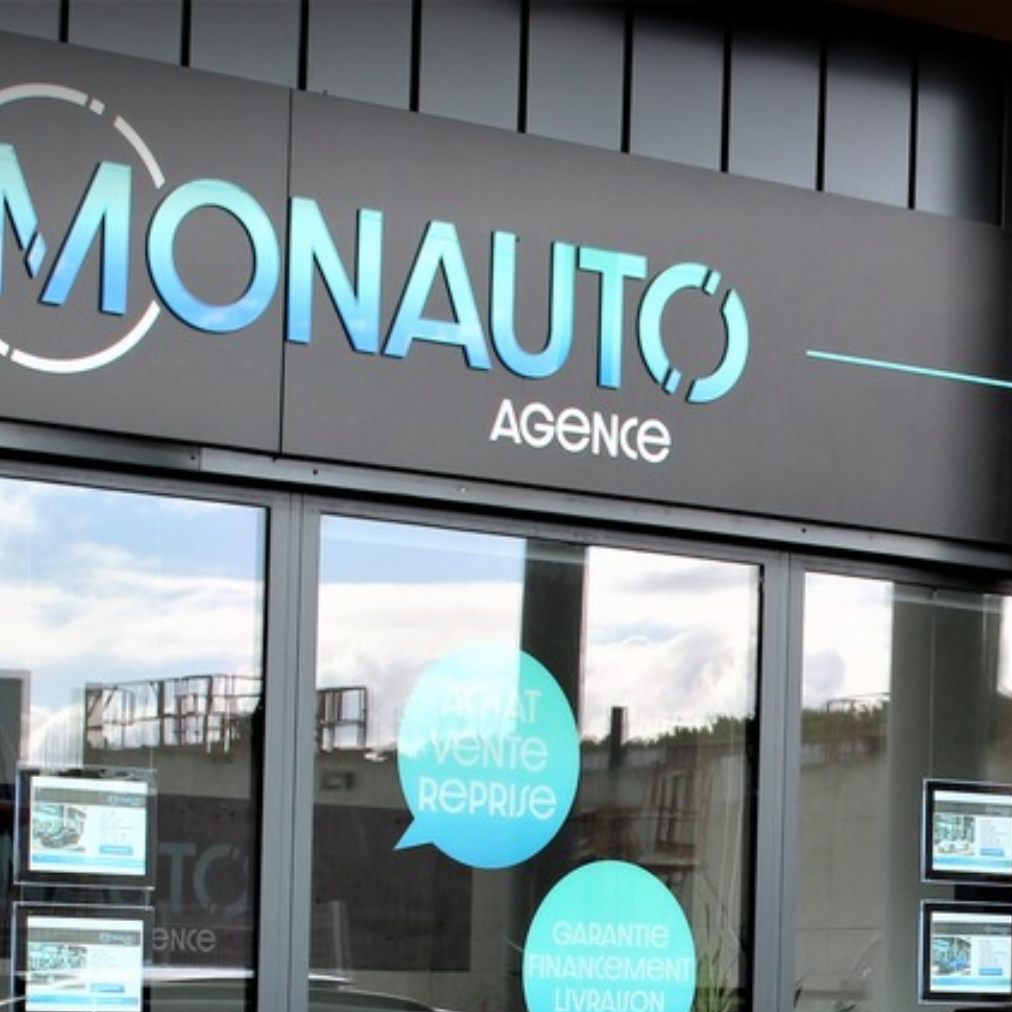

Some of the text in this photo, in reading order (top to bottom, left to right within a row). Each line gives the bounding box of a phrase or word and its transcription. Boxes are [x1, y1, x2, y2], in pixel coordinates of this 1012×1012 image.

[0, 143, 749, 404] MONAUTO
[490, 399, 672, 464] AGENCE
[152, 926, 217, 954] ENCE
